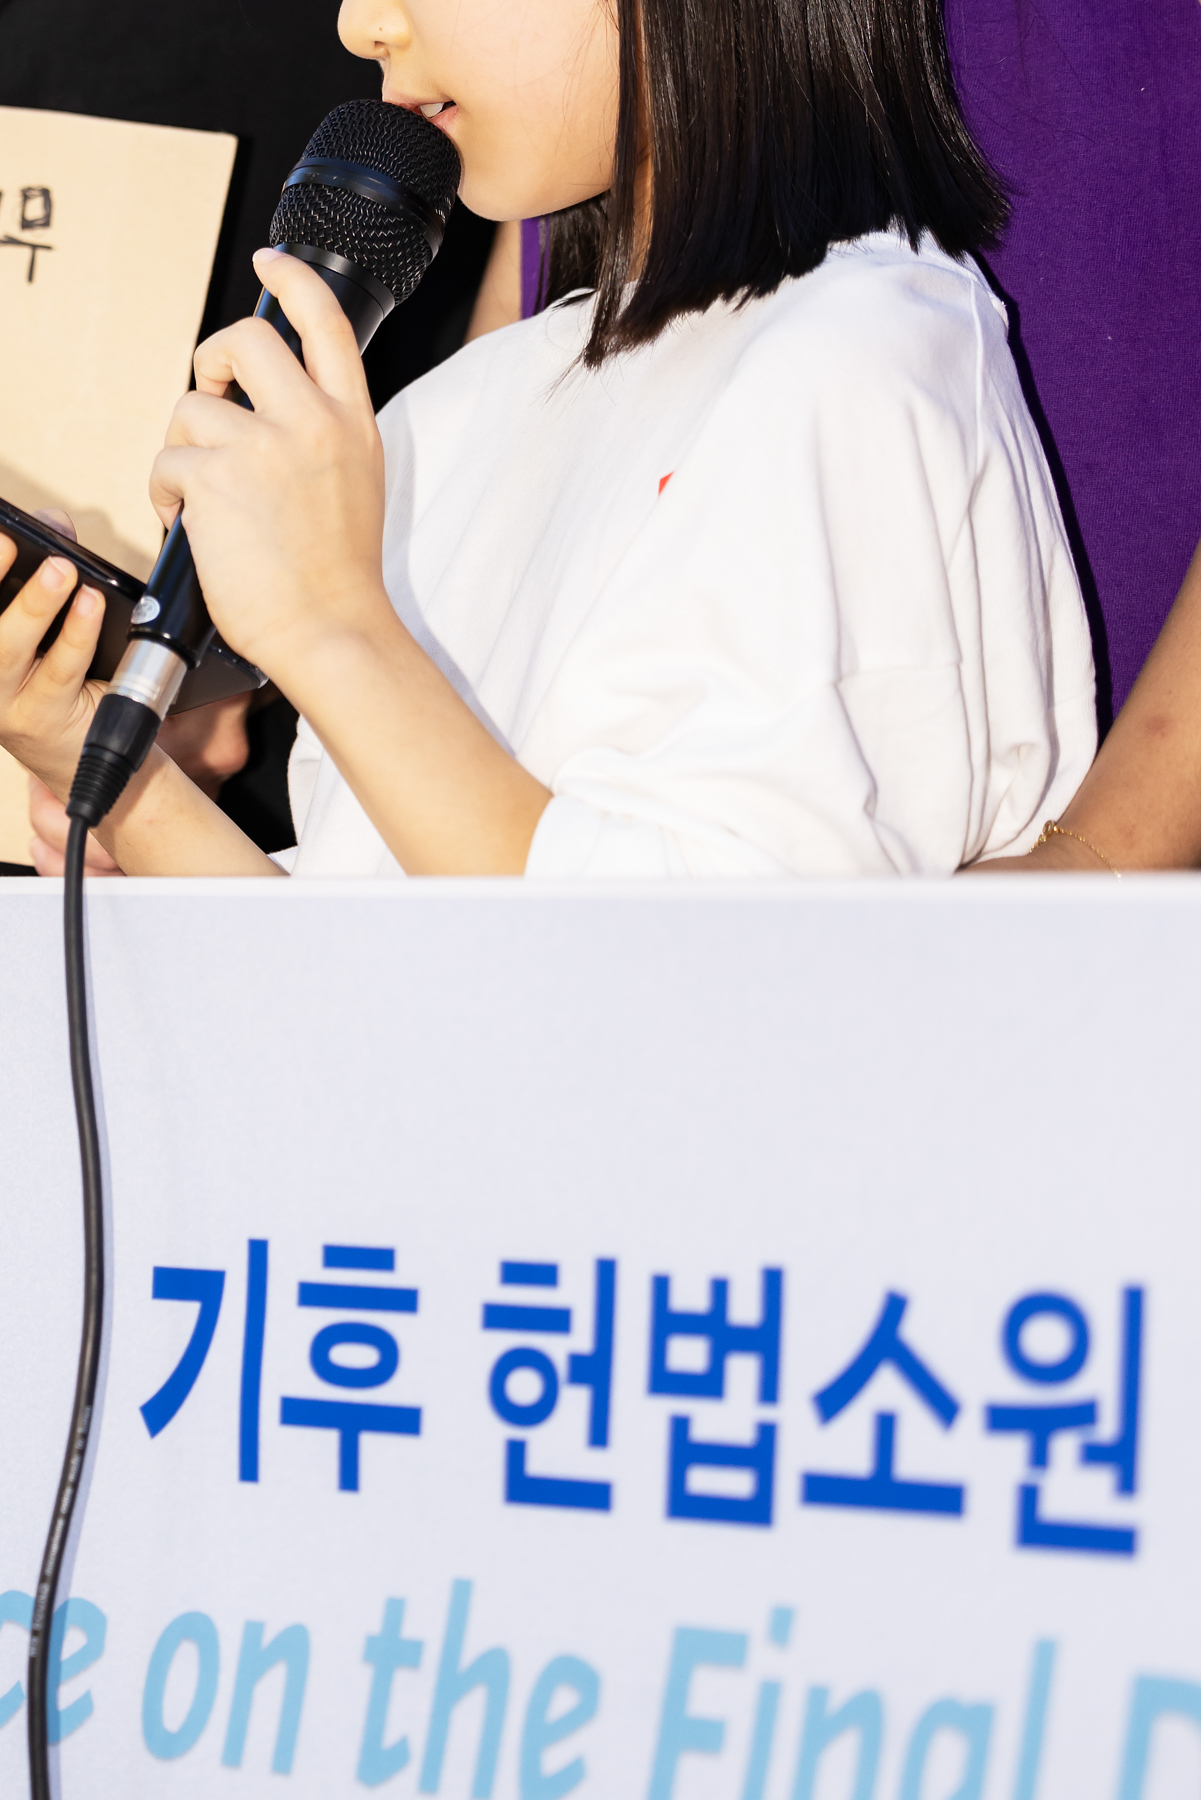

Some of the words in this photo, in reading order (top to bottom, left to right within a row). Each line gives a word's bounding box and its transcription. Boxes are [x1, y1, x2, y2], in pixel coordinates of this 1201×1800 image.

[139, 1238, 423, 1494] 기후
[480, 1256, 1147, 1560] 헌법소원
[142, 1612, 309, 1773] on
[357, 1580, 600, 1800] the
[647, 1607, 1055, 1800] Final
